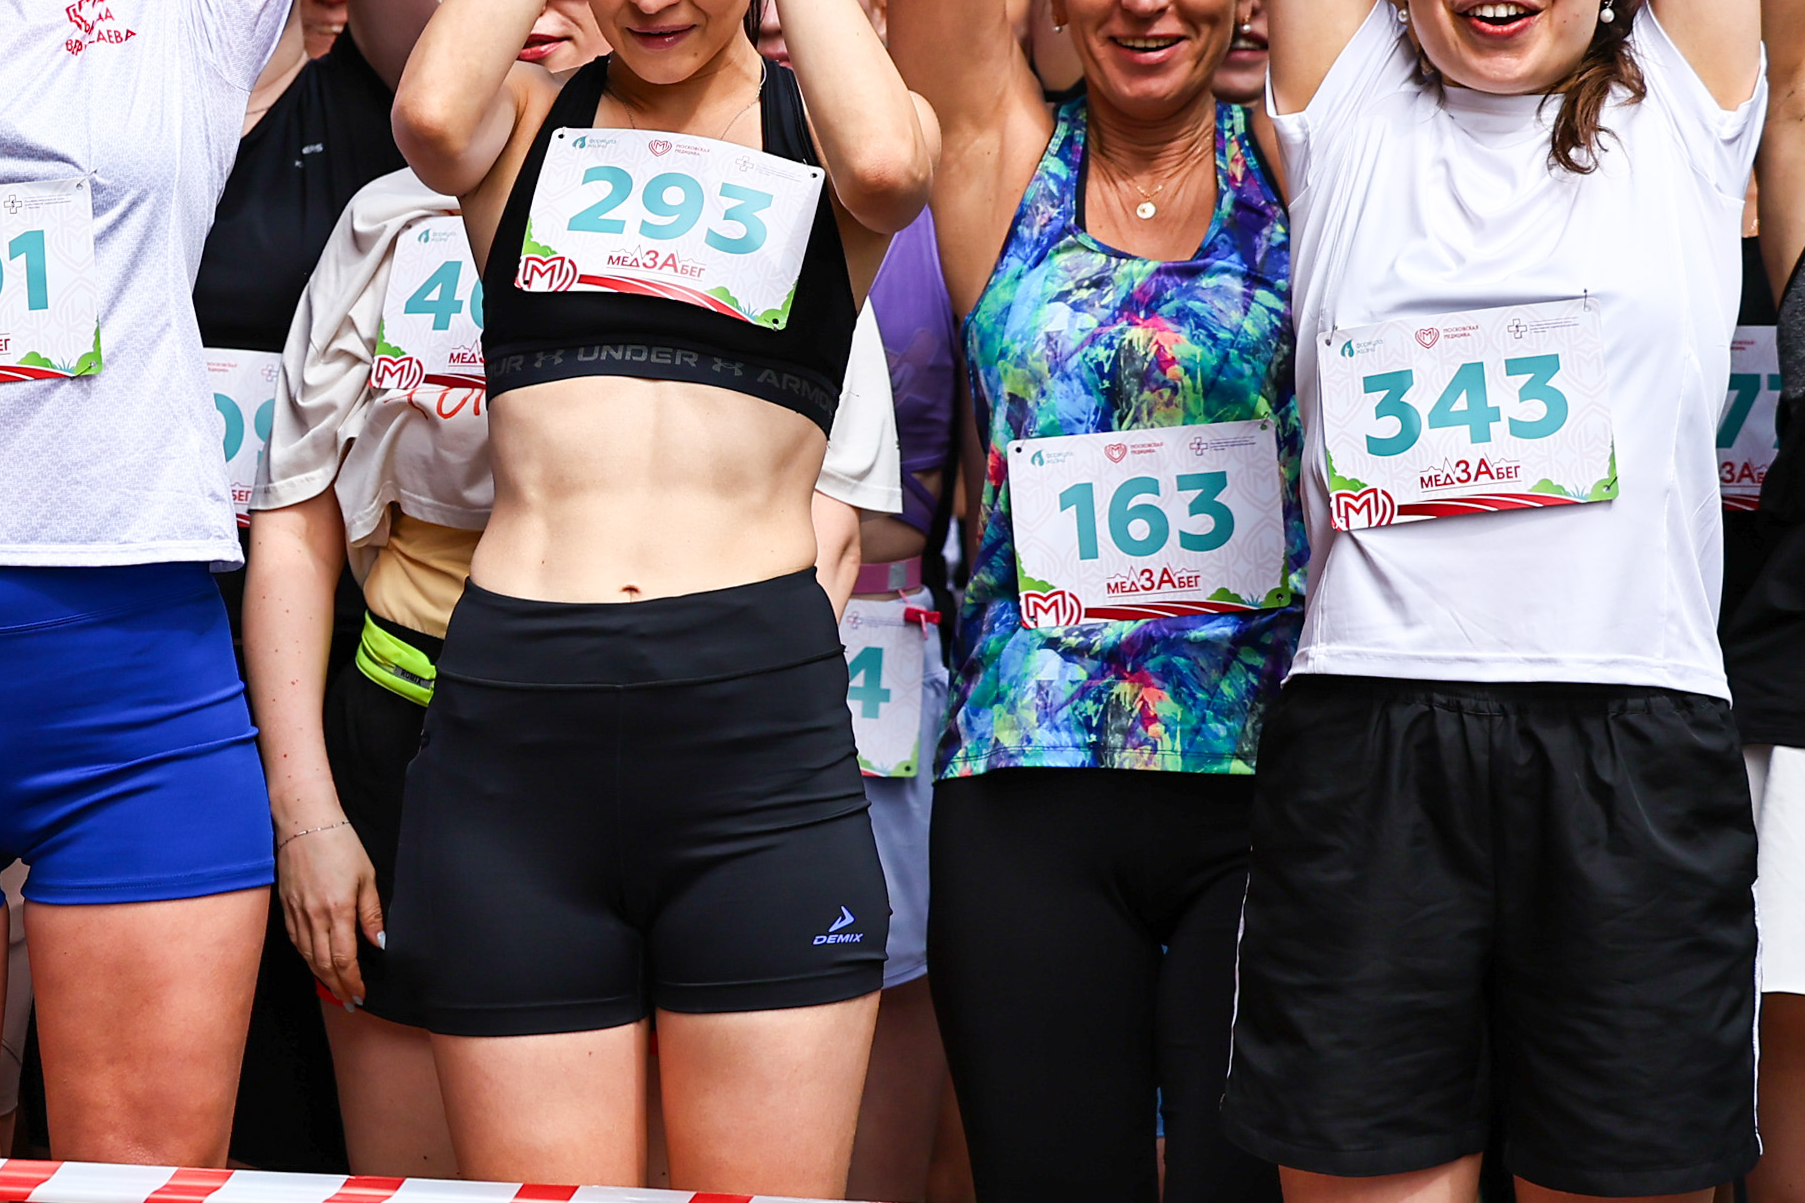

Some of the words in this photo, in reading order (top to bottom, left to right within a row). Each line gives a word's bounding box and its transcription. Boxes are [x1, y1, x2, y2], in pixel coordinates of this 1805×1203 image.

[566, 165, 774, 255] 293
[576, 344, 699, 368] UNDER
[757, 368, 833, 412] ARMO
[1362, 353, 1569, 457] 343
[1716, 373, 1783, 449] 7
[1058, 470, 1236, 561] 163
[847, 647, 891, 719] 4
[812, 933, 864, 946] DEMIX
